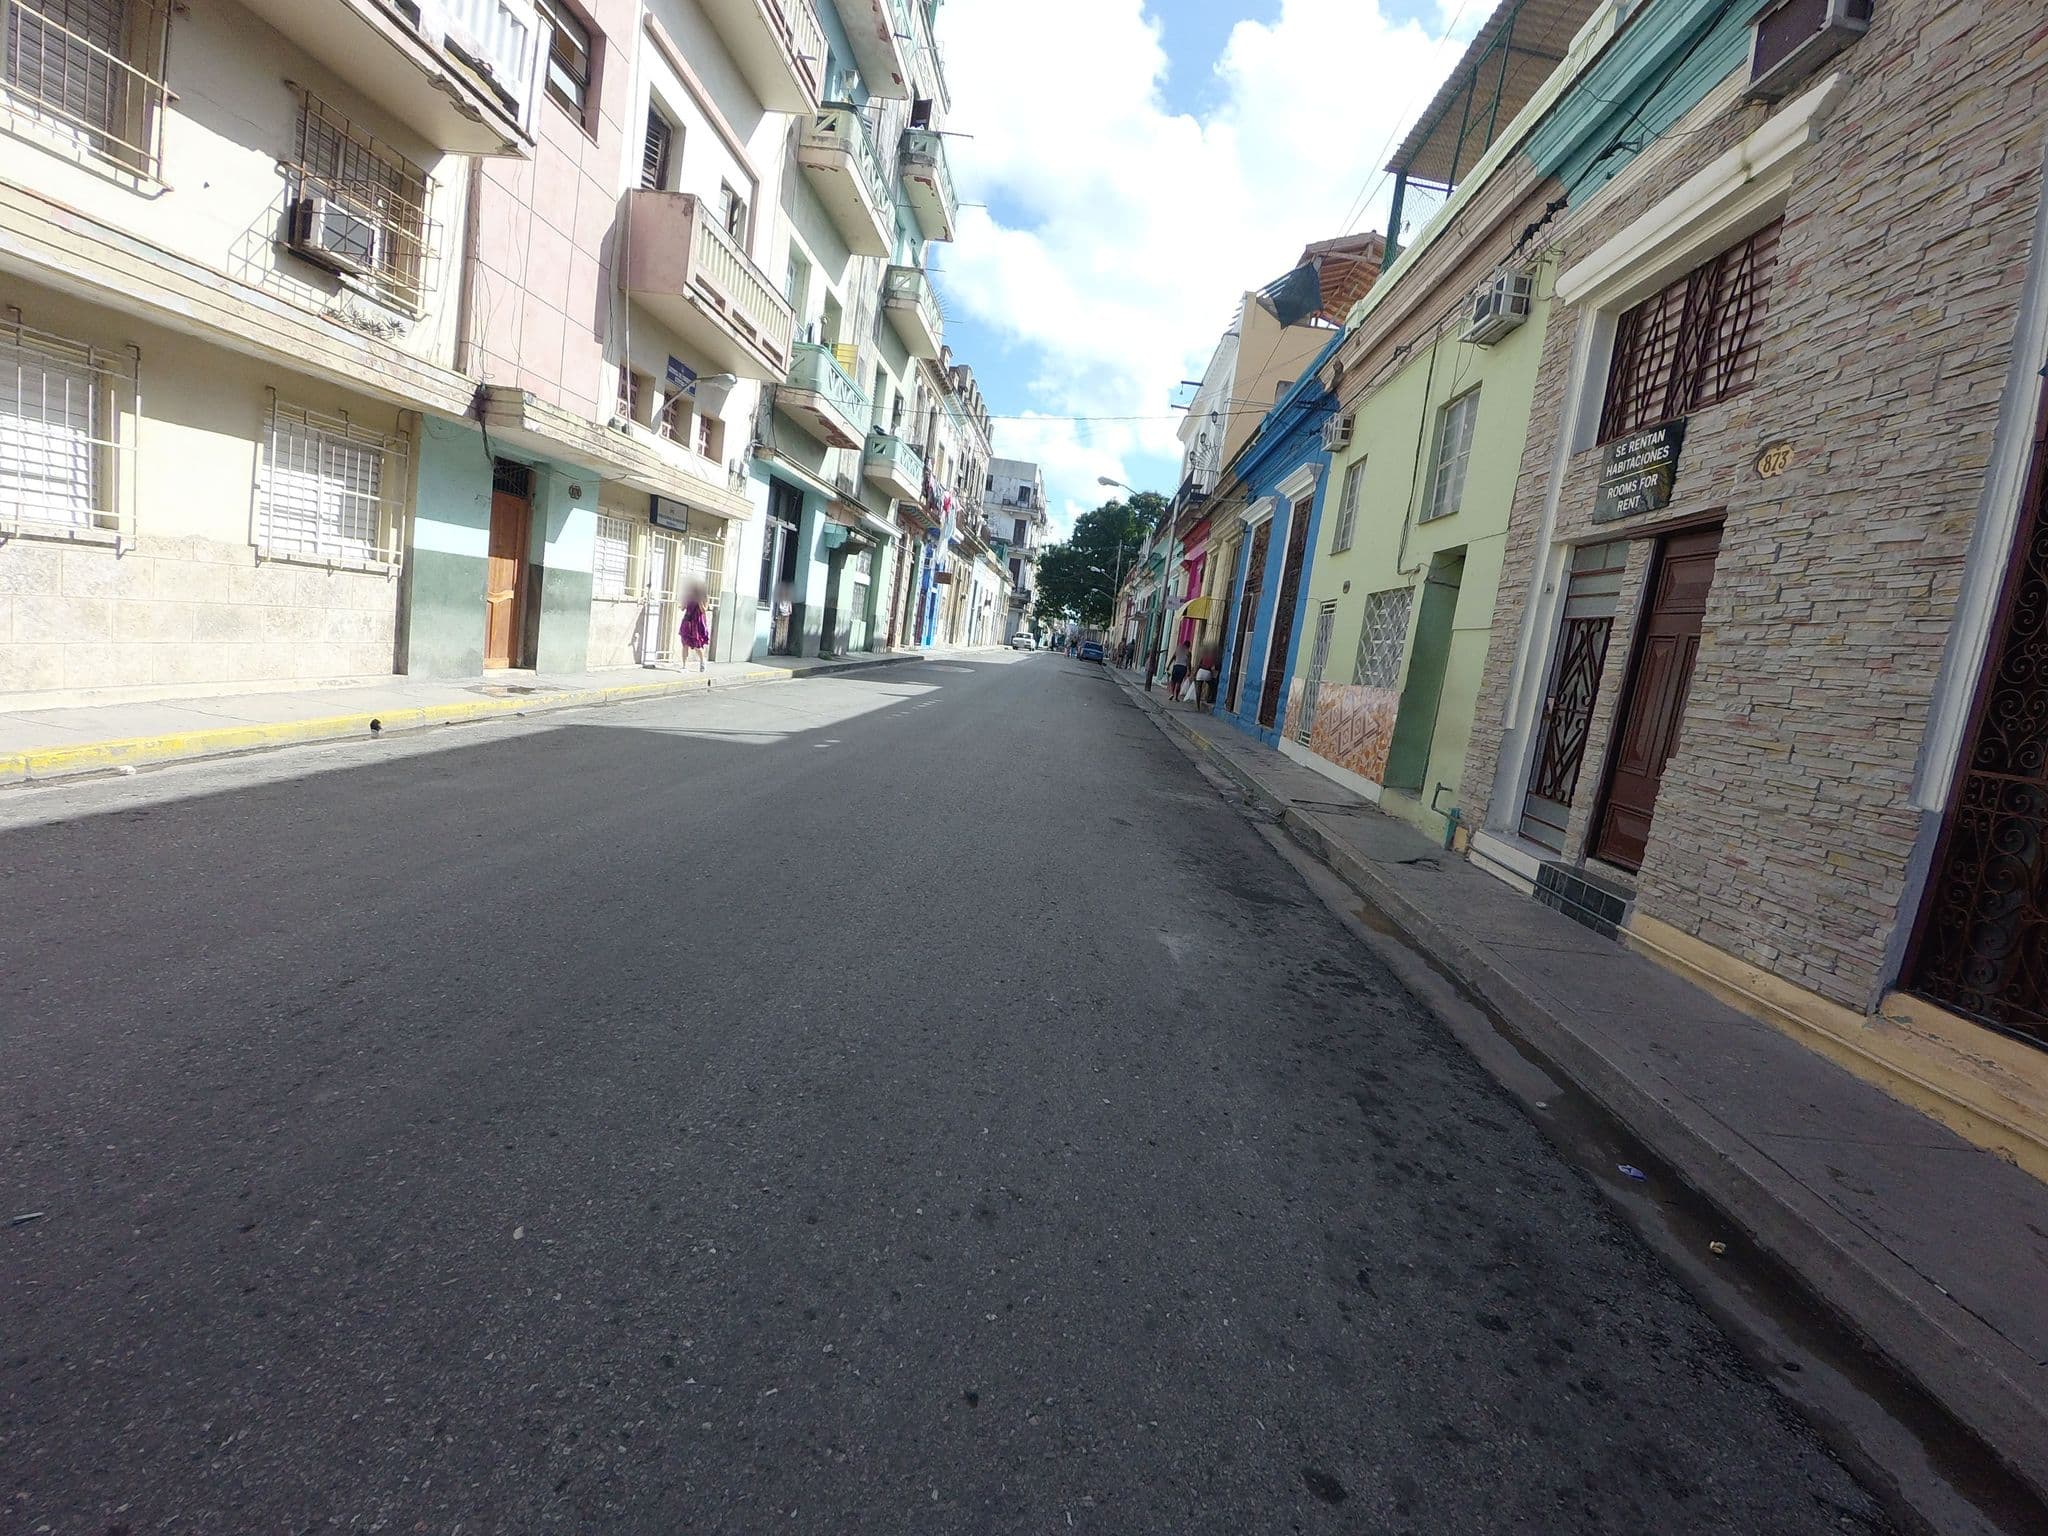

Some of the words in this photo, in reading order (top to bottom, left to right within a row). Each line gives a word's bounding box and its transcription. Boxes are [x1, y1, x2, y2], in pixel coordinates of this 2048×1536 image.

[1615, 443, 1628, 458] SE
[1628, 429, 1666, 453] RENTAN
[1606, 445, 1670, 477] HABITACIONES
[1763, 450, 1790, 473] 873
[1607, 480, 1638, 500] ROOMS
[1639, 473, 1658, 490] FOR
[1617, 495, 1641, 512] RENT
